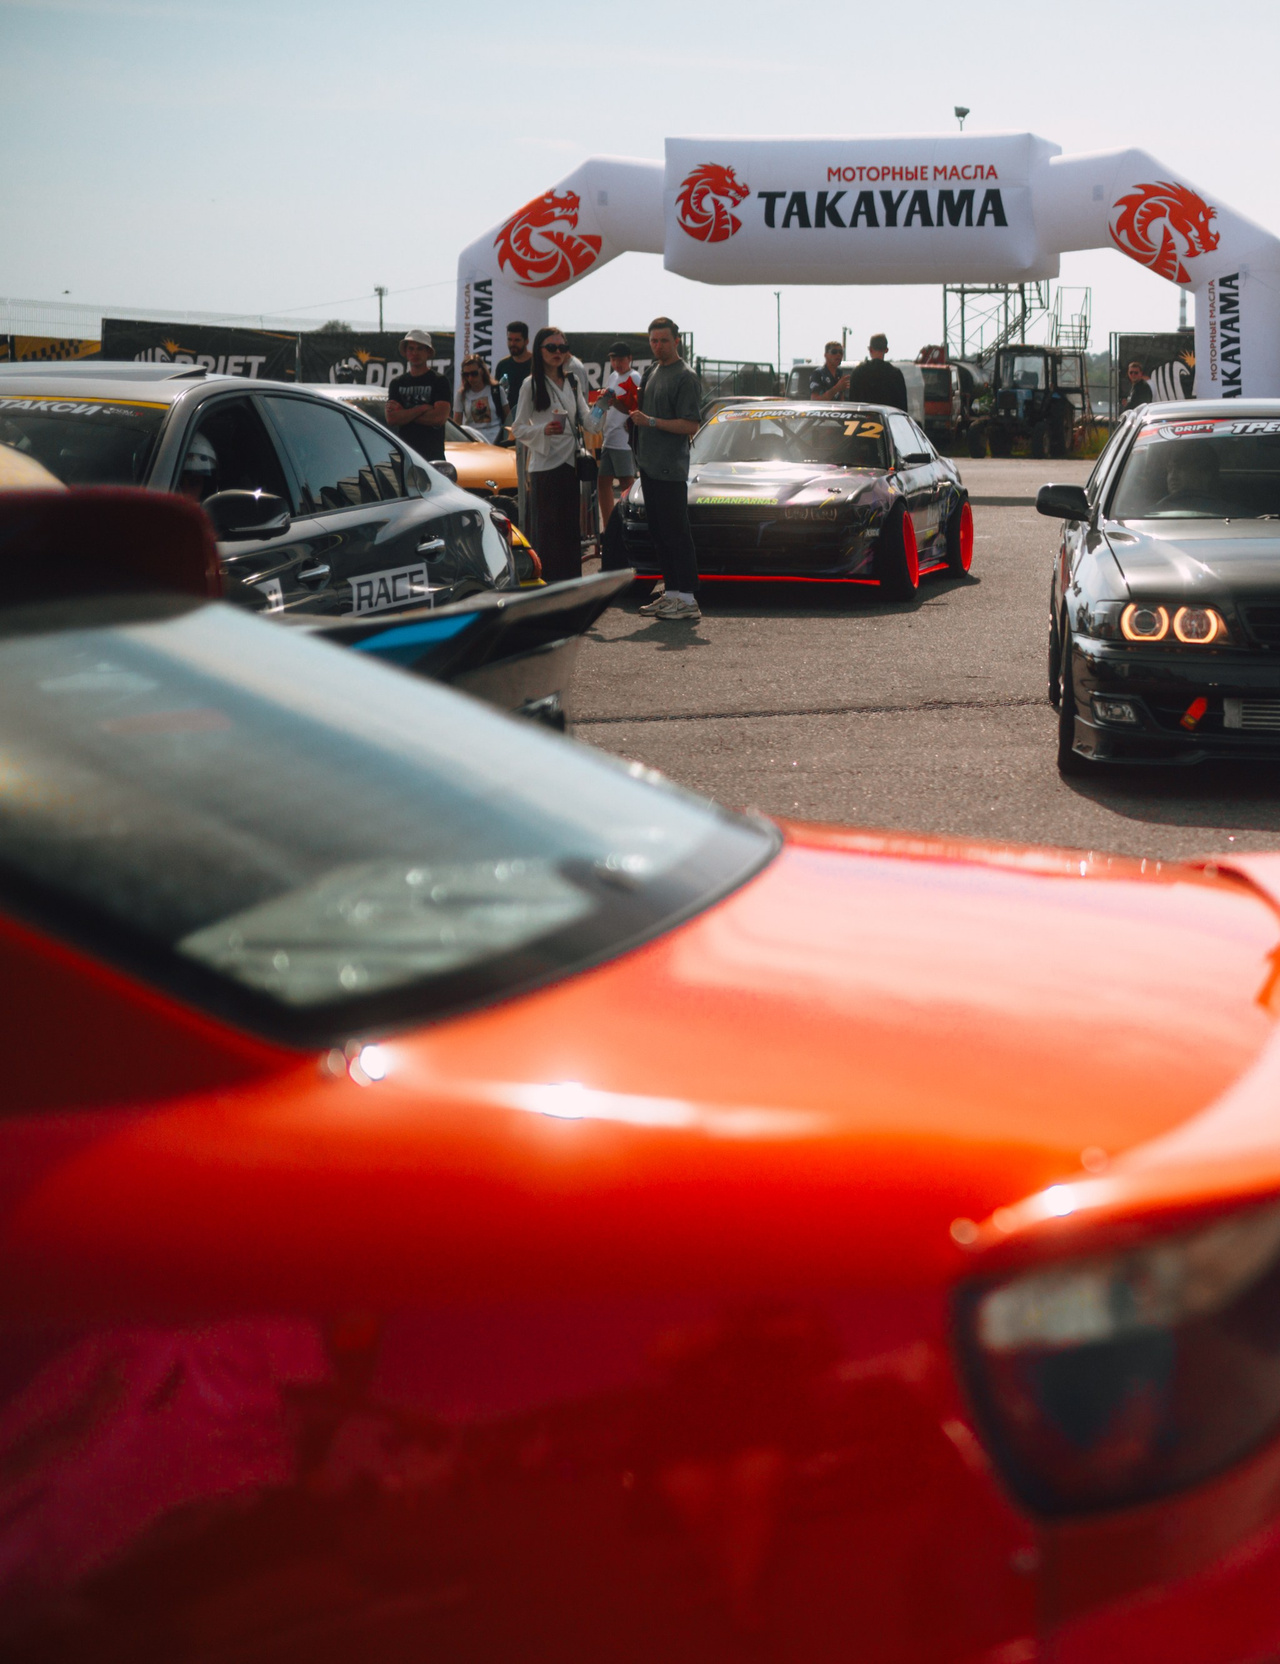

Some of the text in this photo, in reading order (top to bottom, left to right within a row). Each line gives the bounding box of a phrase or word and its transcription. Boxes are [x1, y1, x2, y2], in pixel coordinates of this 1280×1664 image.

[827, 165, 998, 182] МОТОРНЫЕ МАСЛА
[757, 188, 1008, 228] TAKAYAMA
[1207, 279, 1218, 381] МОТОРНЫЕ МАСЛА
[1218, 272, 1242, 399] AKAYAMA
[0, 399, 102, 416] ТАКСИ
[805, 411, 853, 420] ТАКСИ
[843, 420, 885, 439] 12
[1174, 423, 1214, 432] DRIFT
[357, 569, 425, 611] RACE
